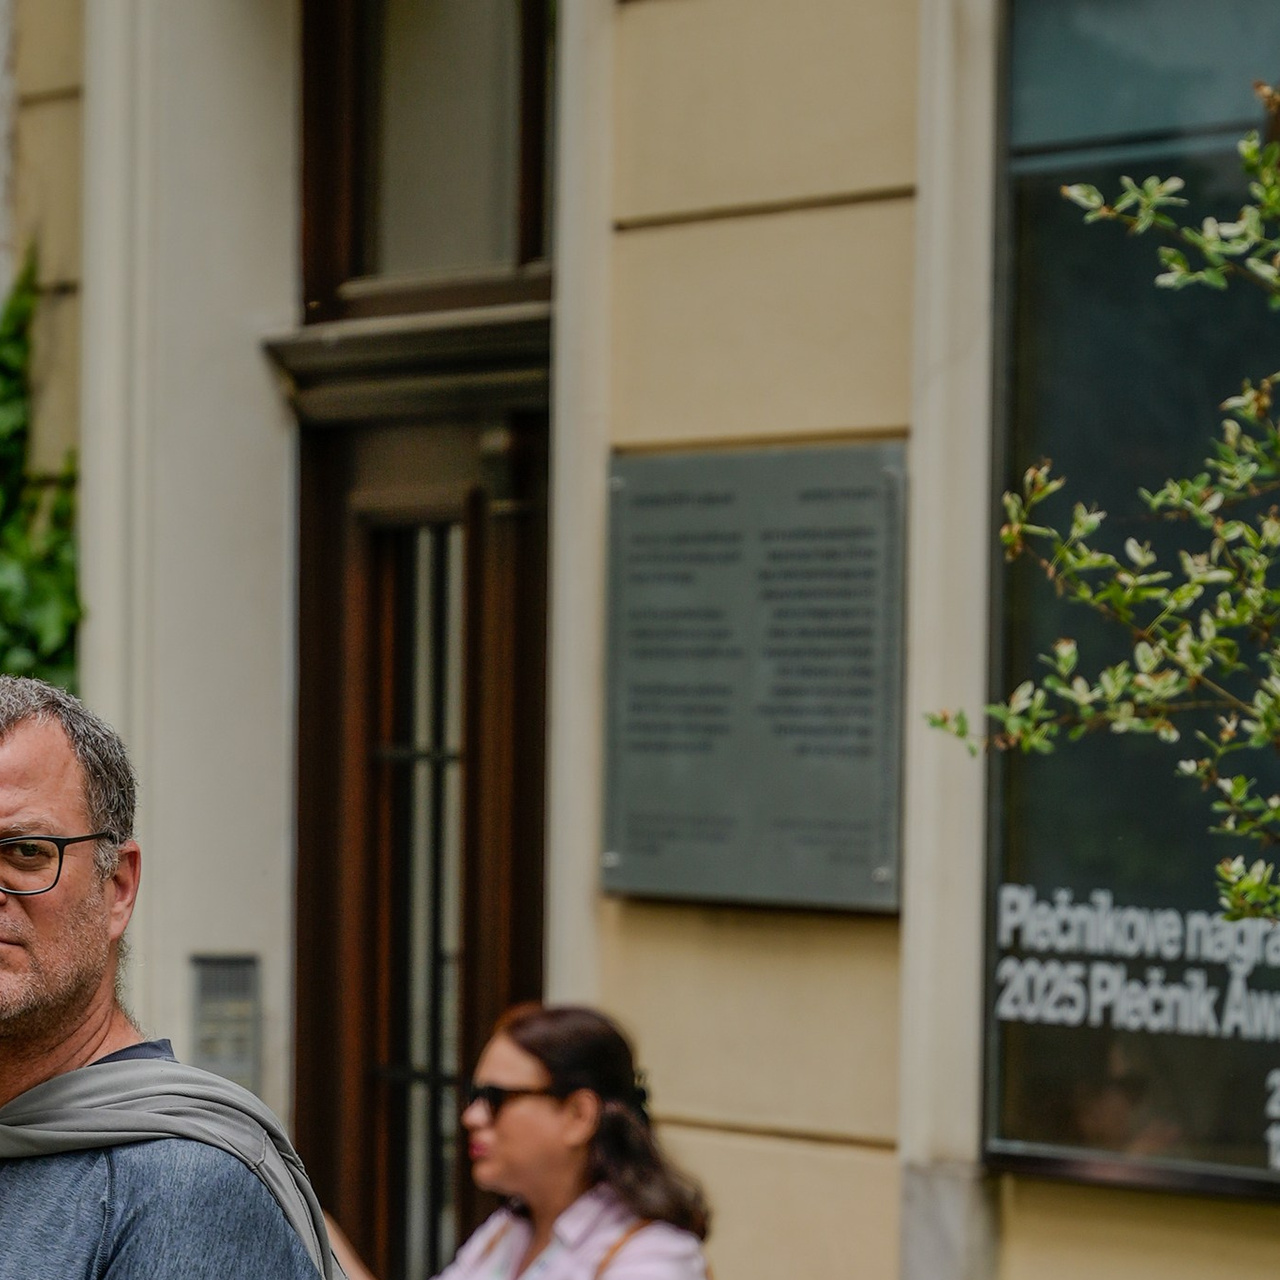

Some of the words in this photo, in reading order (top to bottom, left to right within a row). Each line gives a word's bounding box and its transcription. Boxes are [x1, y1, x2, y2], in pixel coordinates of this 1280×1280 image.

[997, 884, 1184, 959] Plečnikove
[996, 957, 1086, 1026] 2025
[1088, 961, 1219, 1038] Plečnik
